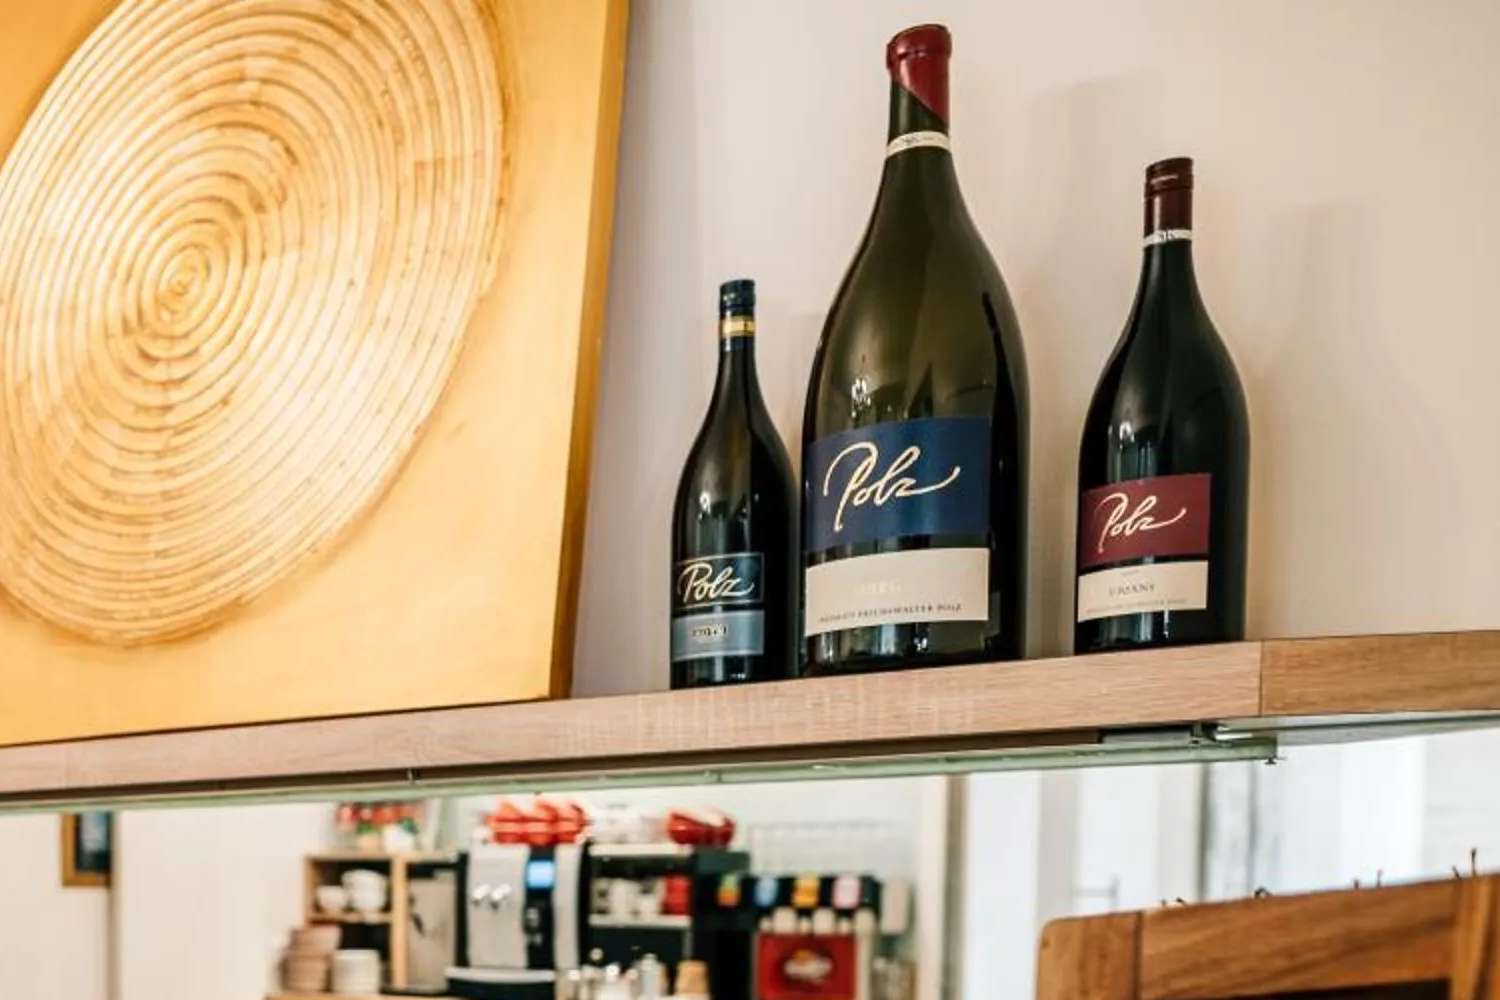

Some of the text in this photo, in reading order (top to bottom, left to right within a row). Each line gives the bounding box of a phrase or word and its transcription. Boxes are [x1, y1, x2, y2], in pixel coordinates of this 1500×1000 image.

[822, 440, 961, 532] Polz
[1093, 491, 1188, 553] Polz
[677, 561, 756, 602] Polz
